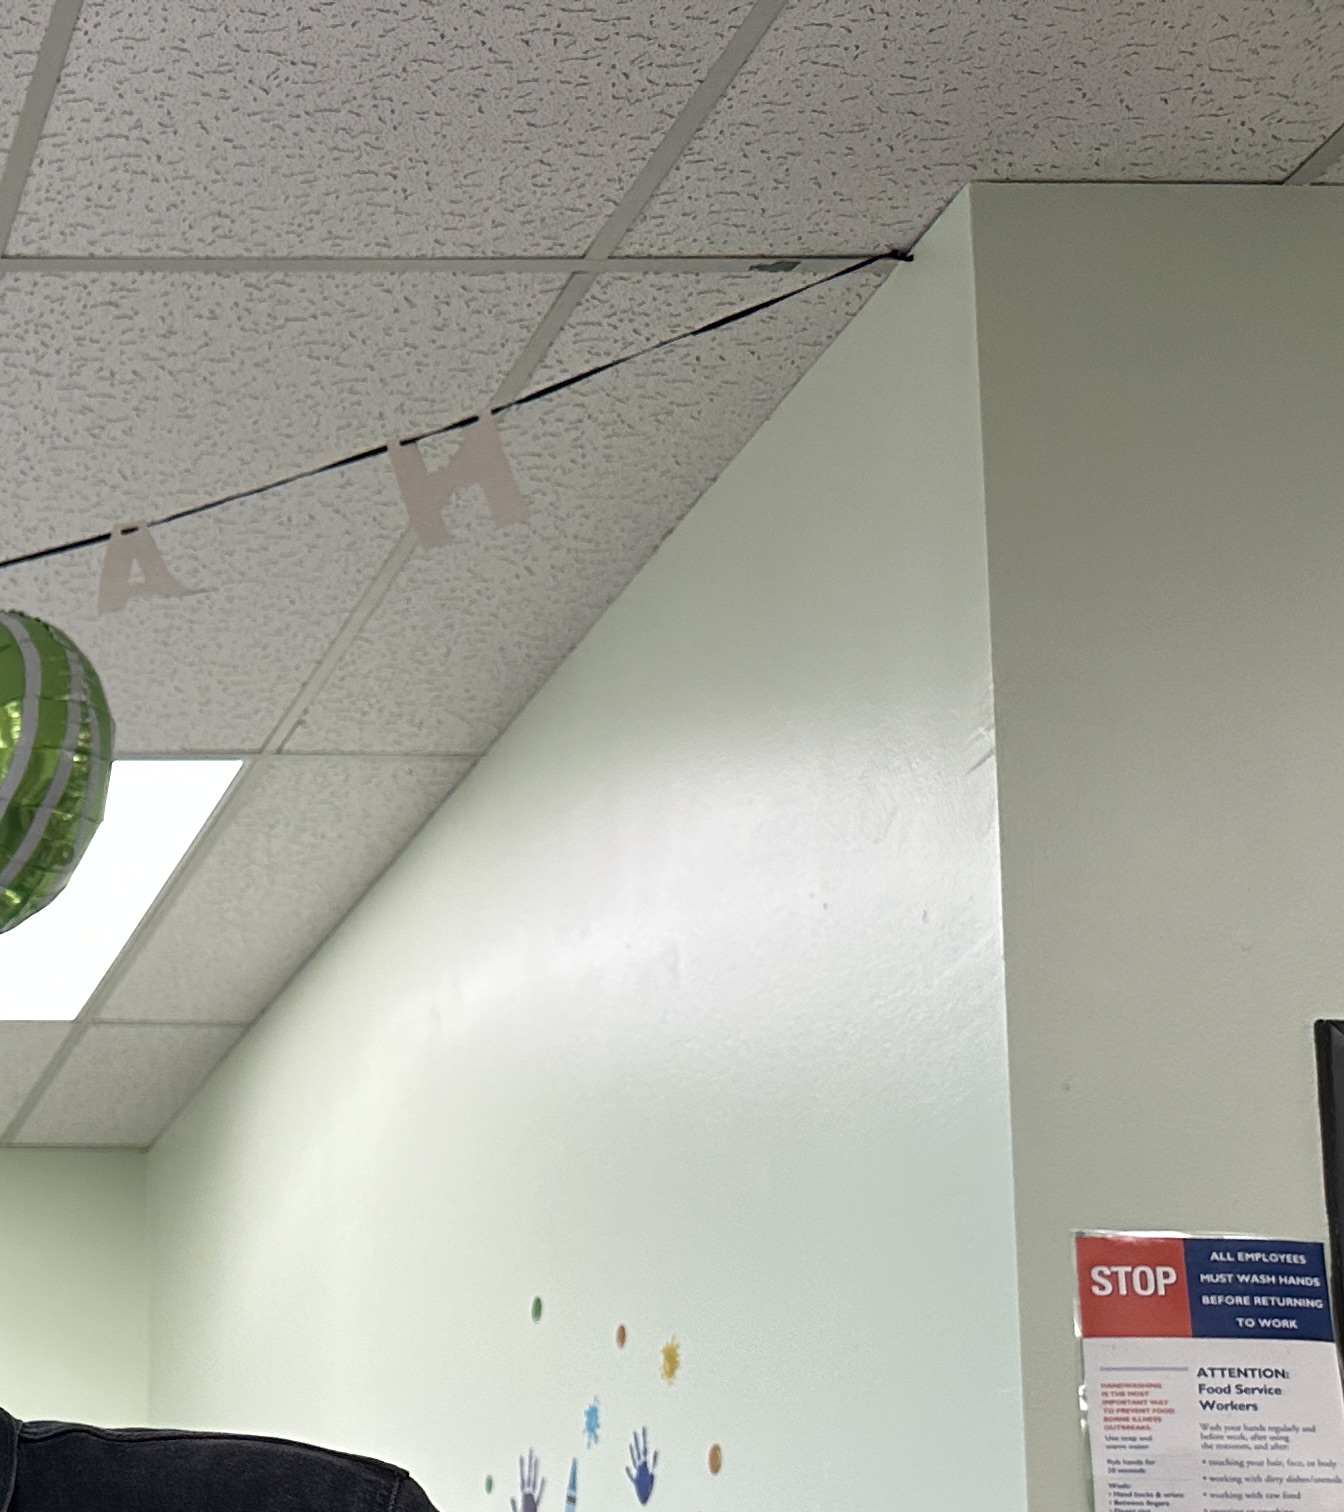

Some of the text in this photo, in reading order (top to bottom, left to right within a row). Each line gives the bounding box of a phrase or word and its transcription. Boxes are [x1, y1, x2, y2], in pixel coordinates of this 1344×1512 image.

[1210, 1251, 1306, 1265] ALL EMPLOYEES
[1090, 1265, 1177, 1296] STOP
[1200, 1273, 1321, 1287] MUST WASH HANDS
[1202, 1295, 1323, 1309] BEFORE RETURNING
[1236, 1317, 1298, 1329] TO WORK
[1197, 1367, 1290, 1379] ATTENTION:
[1198, 1384, 1282, 1395] Food Service
[1199, 1400, 1258, 1411] Workers
